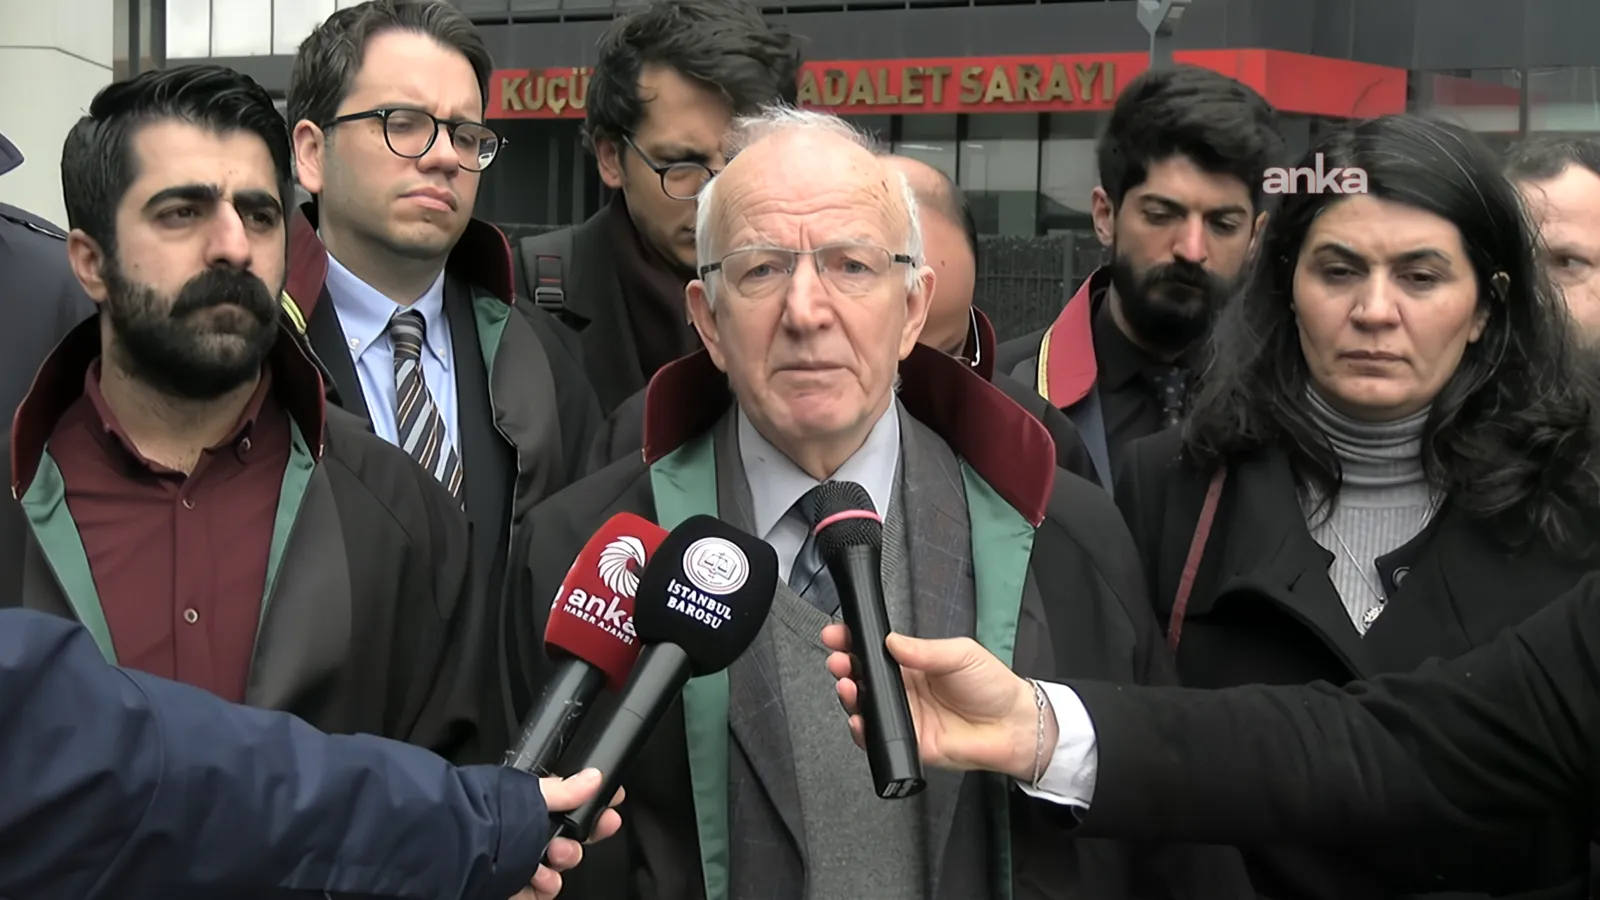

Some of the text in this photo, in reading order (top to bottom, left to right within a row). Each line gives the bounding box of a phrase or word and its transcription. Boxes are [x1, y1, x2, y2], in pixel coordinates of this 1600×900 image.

[798, 65, 951, 106] ADALET
[958, 62, 1116, 103] SARAYI
[563, 603, 634, 646] HABER AJANSI
[568, 587, 637, 637] anka
[666, 596, 723, 630] BAROSU
